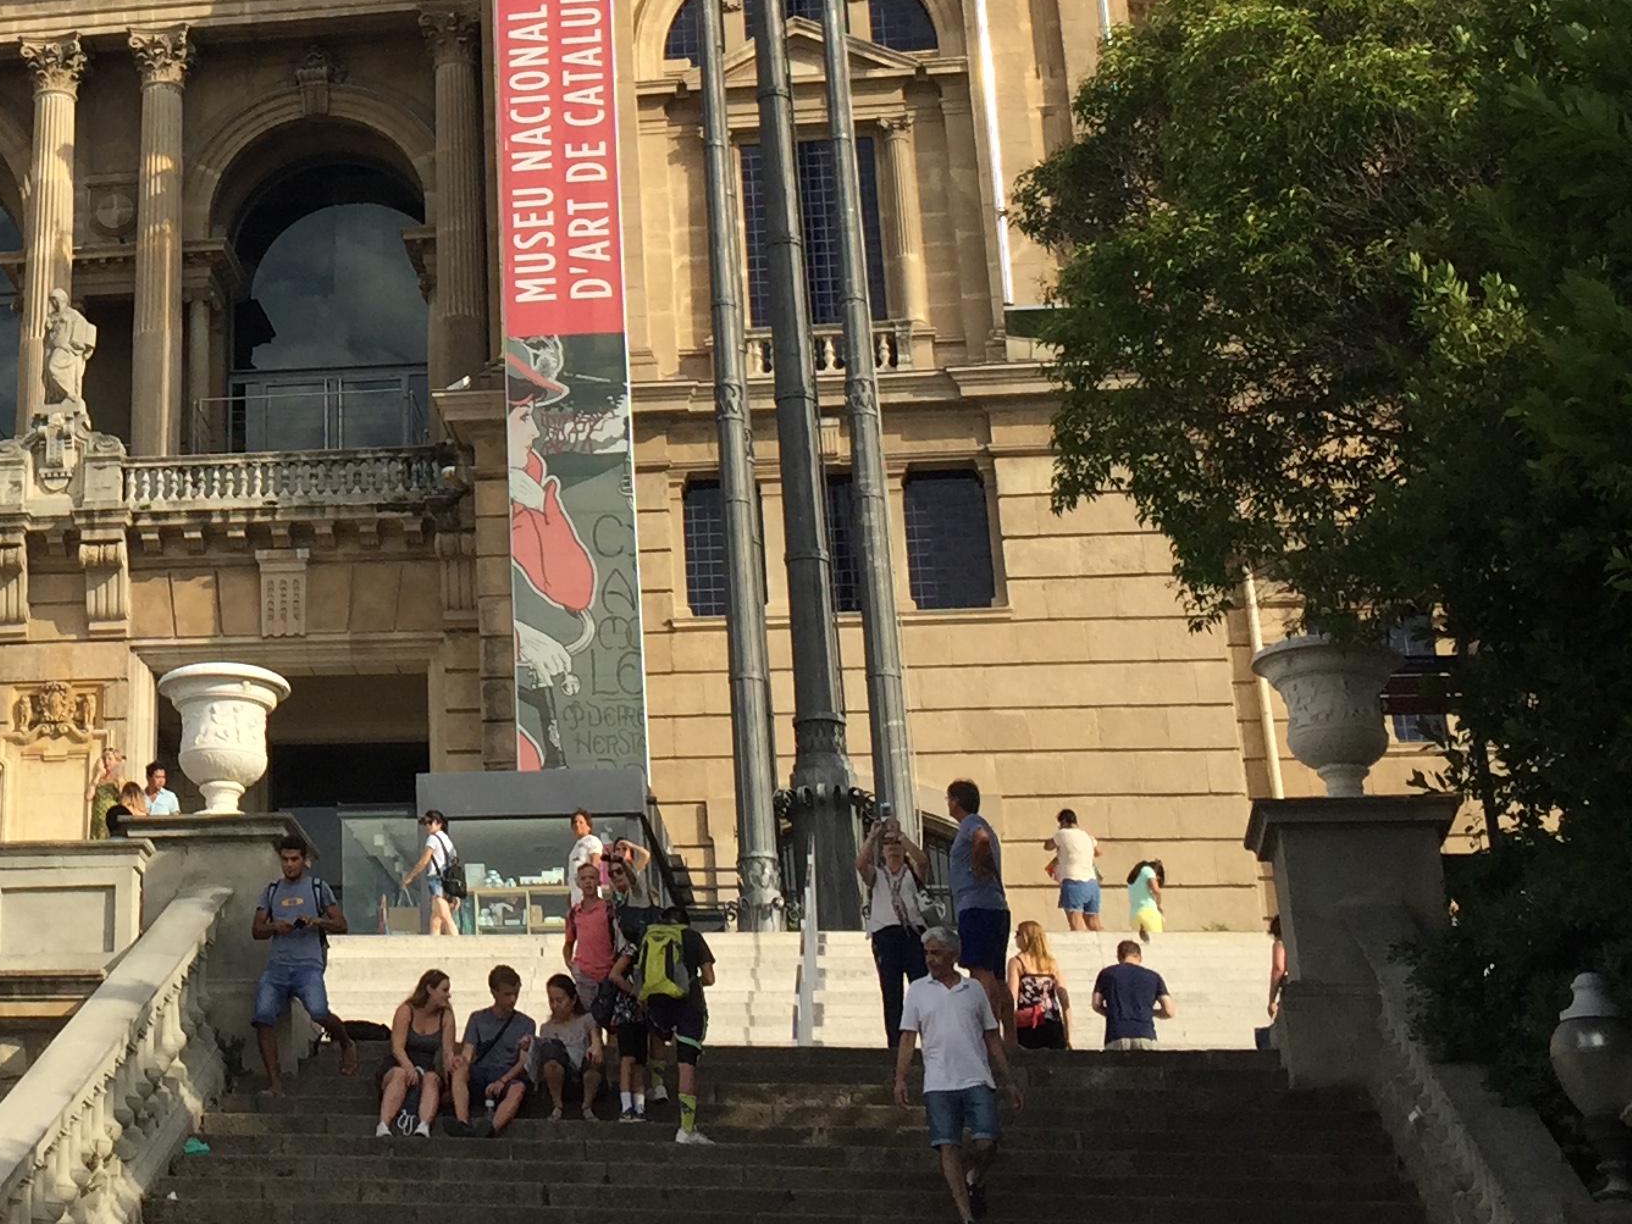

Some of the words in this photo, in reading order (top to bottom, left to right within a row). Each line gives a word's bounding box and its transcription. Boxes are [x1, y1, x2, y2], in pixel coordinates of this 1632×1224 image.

[507, 3, 554, 172] NACIONAL
[564, 140, 608, 183] DE
[511, 187, 558, 303] MUSEU
[565, 198, 613, 300] D'ART
